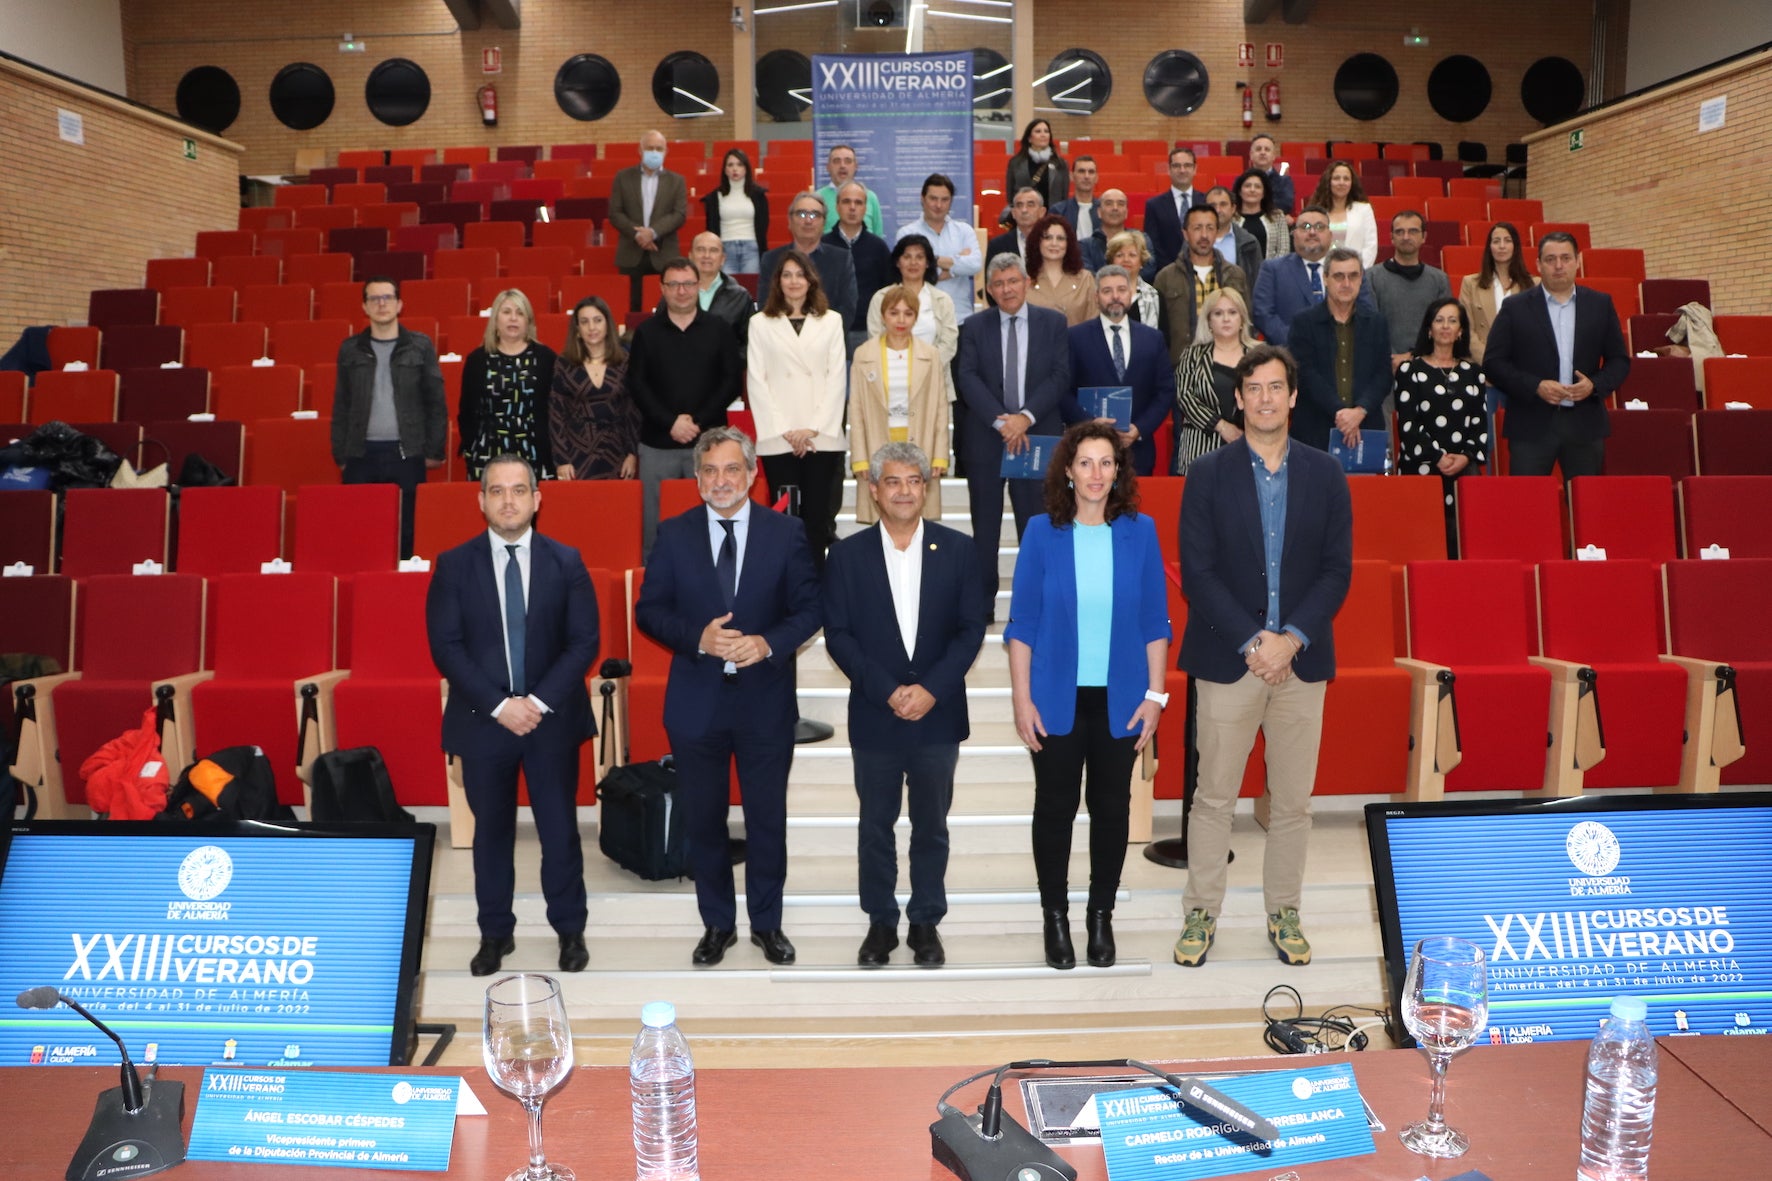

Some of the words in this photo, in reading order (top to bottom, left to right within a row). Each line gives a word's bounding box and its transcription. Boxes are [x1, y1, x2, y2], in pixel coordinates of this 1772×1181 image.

[819, 62, 879, 90] XXIII
[880, 61, 943, 73] CURSOS
[945, 60, 966, 72] DE
[880, 74, 966, 90] VERANO
[819, 92, 894, 100] UNIVERSIDAD
[899, 91, 913, 99] DE
[918, 90, 966, 99] ALMERÍA
[1568, 876, 1631, 887] UNIVERSIDAD
[1570, 886, 1585, 896] DE
[1588, 884, 1632, 896] ALMERÍA
[168, 901, 232, 911] UNIVERSIDAD
[167, 910, 182, 920] DE
[183, 908, 229, 920] ALMERÍA
[1483, 911, 1594, 961] XXIII
[1592, 907, 1691, 929] CURSOS
[1695, 906, 1729, 926] DE
[1593, 929, 1735, 957] VERANO
[63, 933, 175, 981] XXIII
[176, 935, 281, 955] CURSOS
[282, 936, 318, 956] DE
[174, 958, 314, 984] VERANO
[1491, 963, 1615, 979] UNIVERSIDAD
[1626, 962, 1648, 974] DE
[1661, 958, 1741, 973] ALMERÍA
[1556, 979, 1576, 989] del
[1582, 978, 1590, 988] 4
[1597, 978, 1608, 987] al
[1614, 977, 1627, 987] 31
[1633, 976, 1649, 986] de
[1655, 974, 1685, 987] julio
[1690, 974, 1706, 984] de
[1712, 973, 1744, 983] 2022
[59, 987, 183, 1000] UNIVERSIDAD
[195, 988, 217, 1000] DE
[231, 987, 310, 1001] ALMERÍA
[118, 1002, 138, 1011] del
[144, 1002, 153, 1011] 4
[158, 1002, 170, 1011] al
[177, 1003, 190, 1011] 31
[196, 1003, 212, 1012] de
[217, 1003, 249, 1013] julio
[254, 1004, 271, 1013] de
[276, 1005, 310, 1014] 2022
[1509, 1024, 1553, 1036] ALMERÍA
[51, 1045, 97, 1057] ALMERÍA
[208, 1074, 243, 1091] XXIII
[243, 1075, 274, 1083] CURSOS
[242, 1083, 285, 1093] VERANO
[1310, 1077, 1350, 1086] UNIVERSIDAD
[1312, 1085, 1321, 1093] DE
[421, 1093, 451, 1101] ALMERÍA
[1102, 1097, 1140, 1118] XXIII
[1140, 1093, 1171, 1103] CURSOS
[1140, 1100, 1185, 1113] VERANO
[1202, 1093, 1256, 1129] SENNHEISER
[244, 1109, 284, 1123] ÁNGEL
[287, 1113, 342, 1126] ESCOBAR
[345, 1113, 405, 1128] CÉSPEDES
[1105, 1117, 1147, 1126] UNIVERSIDAD
[266, 1134, 337, 1147] Vicepresidente
[338, 1138, 376, 1148] primero
[1125, 1130, 1184, 1147] CARMELO
[1186, 1122, 1244, 1139] RODRÍGU
[228, 1145, 242, 1155] de
[244, 1146, 253, 1155] la
[254, 1146, 306, 1158] Diputación
[308, 1149, 355, 1160] Provincial
[357, 1151, 370, 1161] de
[372, 1152, 408, 1162] Almería
[1154, 1152, 1187, 1164] Rector
[1189, 1150, 1202, 1160] de
[1204, 1148, 1213, 1159] la
[1215, 1140, 1272, 1158] Universidad
[1274, 1138, 1286, 1149] de
[1289, 1133, 1325, 1147] Almería
[107, 1163, 150, 1174] SENNHEISER
